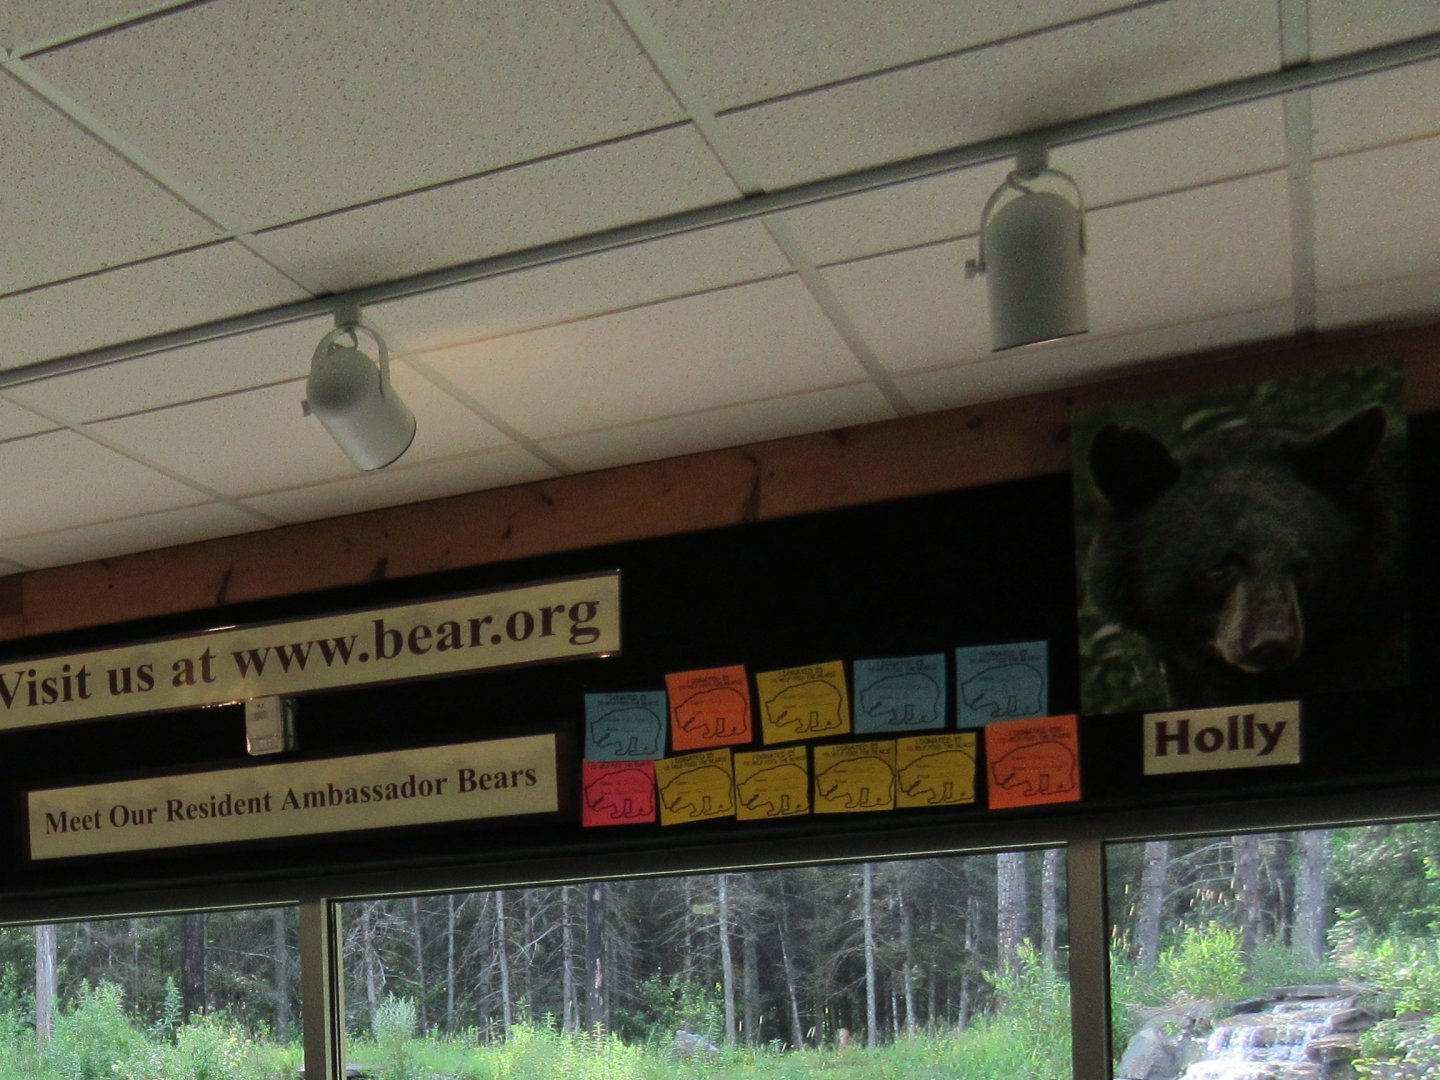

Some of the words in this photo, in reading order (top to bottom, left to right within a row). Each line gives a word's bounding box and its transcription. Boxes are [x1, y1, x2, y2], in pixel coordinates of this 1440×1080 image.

[106, 663, 155, 697] us
[171, 645, 217, 688] at
[231, 599, 602, 680] www.bear.org
[1154, 713, 1288, 757] Holly
[44, 808, 102, 835] Meet
[110, 804, 158, 828] Our
[166, 791, 273, 822] Resident
[281, 774, 448, 811] Ambassador
[457, 766, 537, 794] Bears
